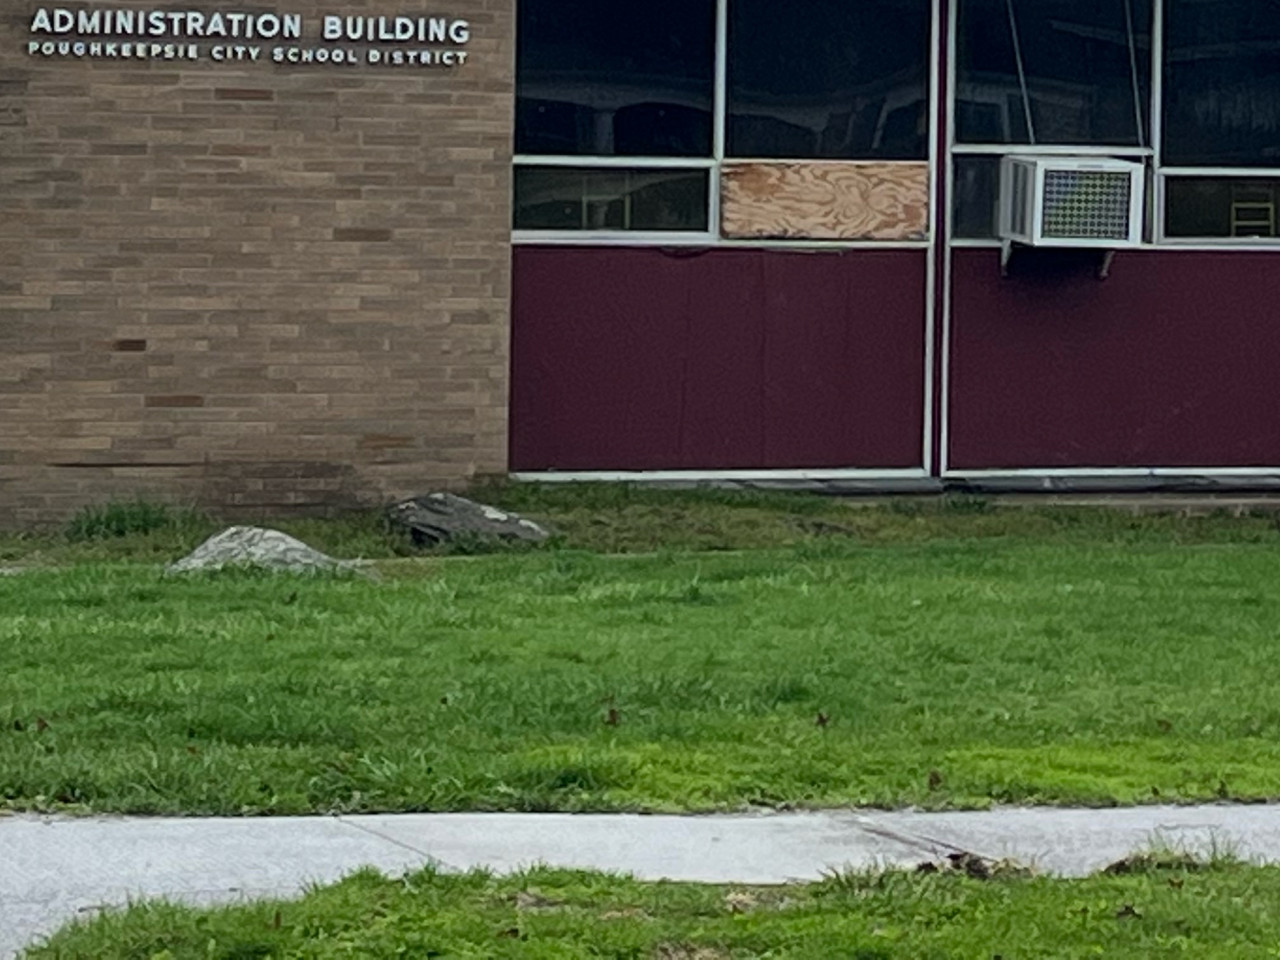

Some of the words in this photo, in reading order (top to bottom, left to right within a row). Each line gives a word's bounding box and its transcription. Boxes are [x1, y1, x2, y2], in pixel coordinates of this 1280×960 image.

[30, 7, 301, 38] ADMINISTRATION
[323, 15, 470, 44] BUILDING
[28, 42, 199, 59] POUGHKEEPSIE
[211, 45, 261, 61] CITY
[272, 46, 358, 63] SCHOOL
[368, 49, 468, 65] DISTRICT
